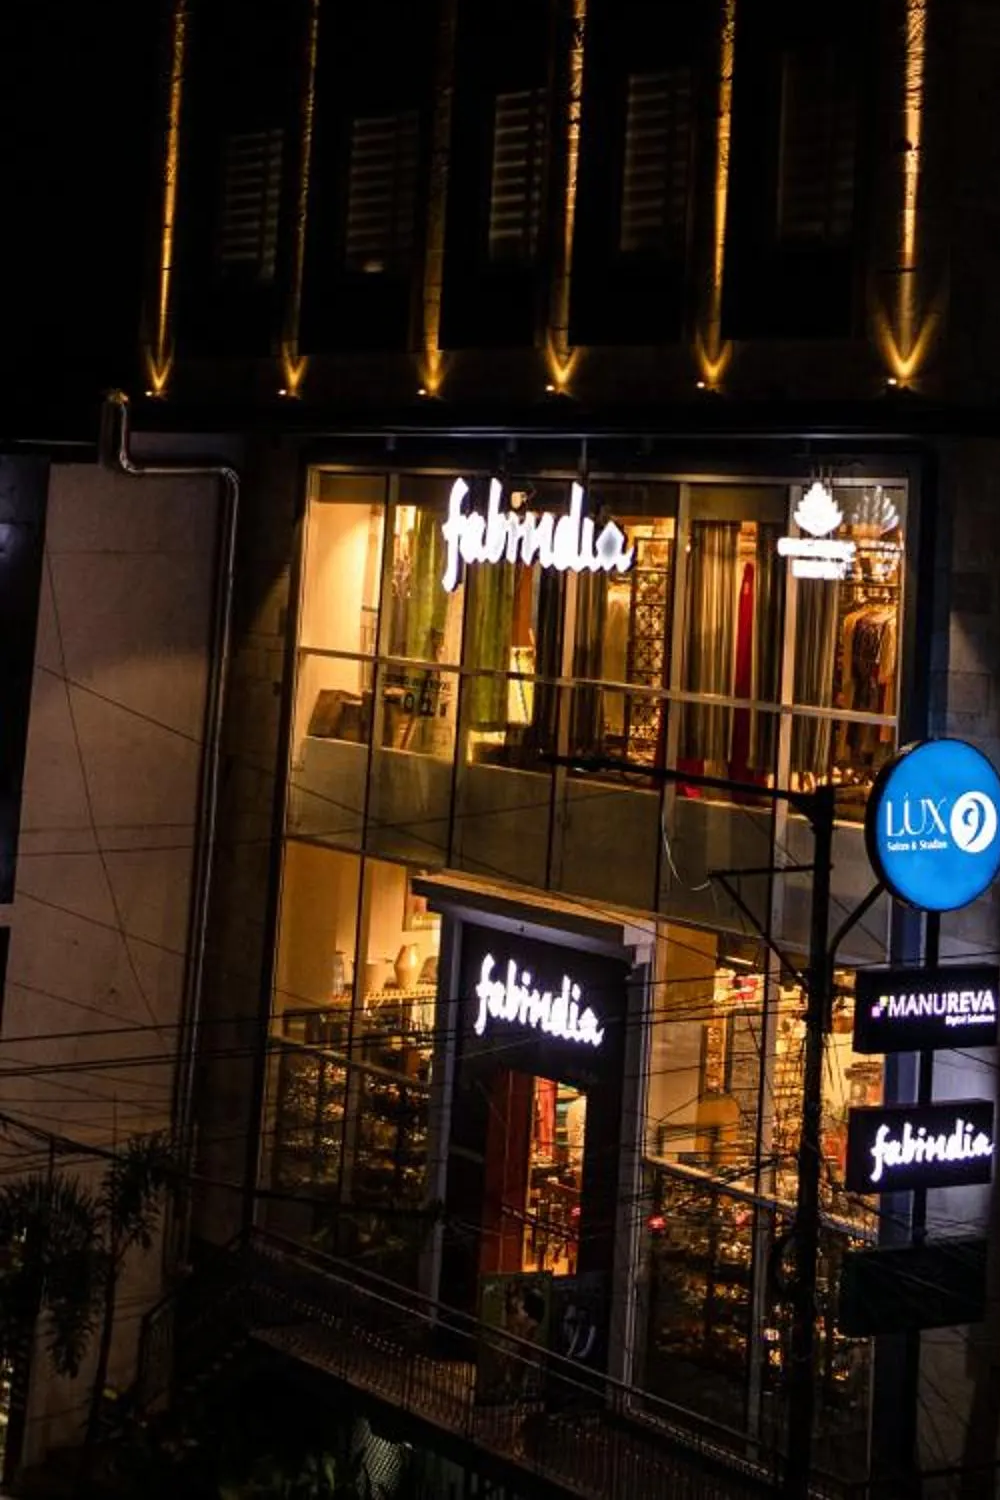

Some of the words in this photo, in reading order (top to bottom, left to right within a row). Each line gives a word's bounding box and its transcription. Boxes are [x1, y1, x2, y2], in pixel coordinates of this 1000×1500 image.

[474, 953, 605, 1047] fabindia
[888, 990, 995, 1017] MANUREVA
[870, 1118, 995, 1182] fabindia
